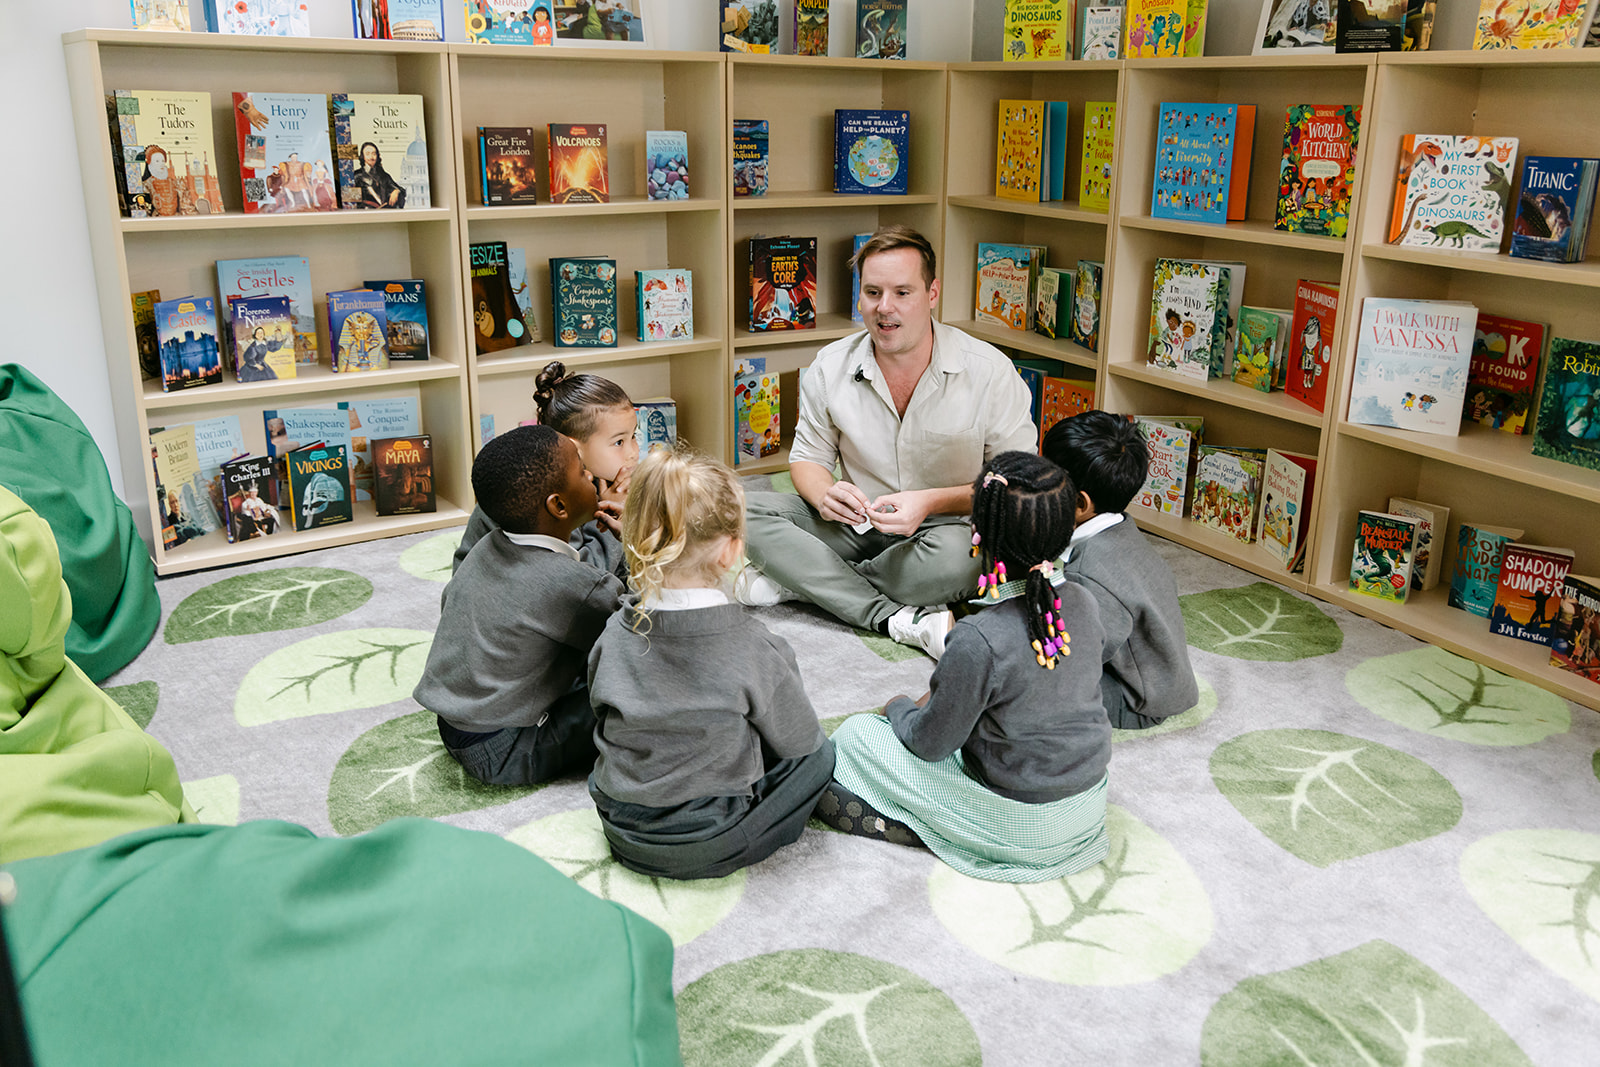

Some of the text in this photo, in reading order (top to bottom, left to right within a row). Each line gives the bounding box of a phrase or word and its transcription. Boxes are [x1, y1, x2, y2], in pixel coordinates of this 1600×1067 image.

[1142, 0, 1175, 10] Dinosaurs
[1011, 10, 1062, 23] DINOSAURS
[1089, 15, 1118, 25] Pond Life
[164, 104, 186, 116] The
[271, 104, 308, 119] Henry
[379, 105, 400, 117] The
[159, 117, 196, 131] Tudors
[279, 120, 300, 131] VIII
[372, 117, 409, 131] Stuarts
[870, 126, 906, 135] PLANET?
[1307, 122, 1343, 142] WORLD
[487, 137, 527, 147] Great Fire
[555, 135, 602, 147] VOLCANOES
[653, 138, 675, 146] ROCKS
[1179, 138, 1211, 150] All About
[500, 146, 531, 156] London
[1301, 140, 1348, 160] KITCHEN
[1443, 151, 1463, 162] MY
[1175, 150, 1213, 168] Diversity
[1450, 164, 1482, 177] FIRST
[1430, 177, 1468, 190] BOOK
[1528, 166, 1575, 191] TITANIC
[1450, 194, 1469, 206] OF
[1417, 206, 1486, 221] DINOSAURS
[771, 260, 800, 273] EARTH'S
[982, 269, 995, 278] HELP
[237, 269, 295, 292] Castles
[773, 271, 797, 284] CORE
[571, 283, 605, 297] Complete
[1170, 285, 1180, 295] I'm
[330, 297, 385, 312] Tutankhamun
[563, 293, 614, 310] Shakespeare
[1184, 295, 1202, 311] KIND
[1297, 286, 1338, 311] GINA KAMINSKI
[237, 304, 271, 319] Florence
[168, 312, 208, 330] Castles
[245, 313, 289, 329] Nightingale
[1375, 309, 1461, 332] I WALK WITH
[1249, 326, 1262, 339] Tree
[1372, 326, 1461, 354] VANESSA
[1488, 363, 1528, 381] FOUND
[286, 419, 345, 431] Shakespeare
[367, 414, 409, 426] Conquest
[288, 430, 345, 440] and the Theatre
[164, 439, 189, 454] Modern
[1147, 440, 1174, 463] Start
[168, 452, 190, 466] Britain
[385, 450, 421, 465] MAYA
[239, 463, 260, 474] King
[294, 456, 343, 476] VIKINGS
[1147, 459, 1176, 481] Cook
[230, 467, 272, 484] Charles III
[1285, 486, 1298, 503] Book
[1360, 521, 1411, 544] BEANSTALK
[1364, 533, 1405, 554] MURDER
[1505, 553, 1569, 581] SHADOW
[1502, 571, 1565, 598] JUMPER
[1564, 584, 1578, 600] THE
[1516, 626, 1549, 643] Forster
